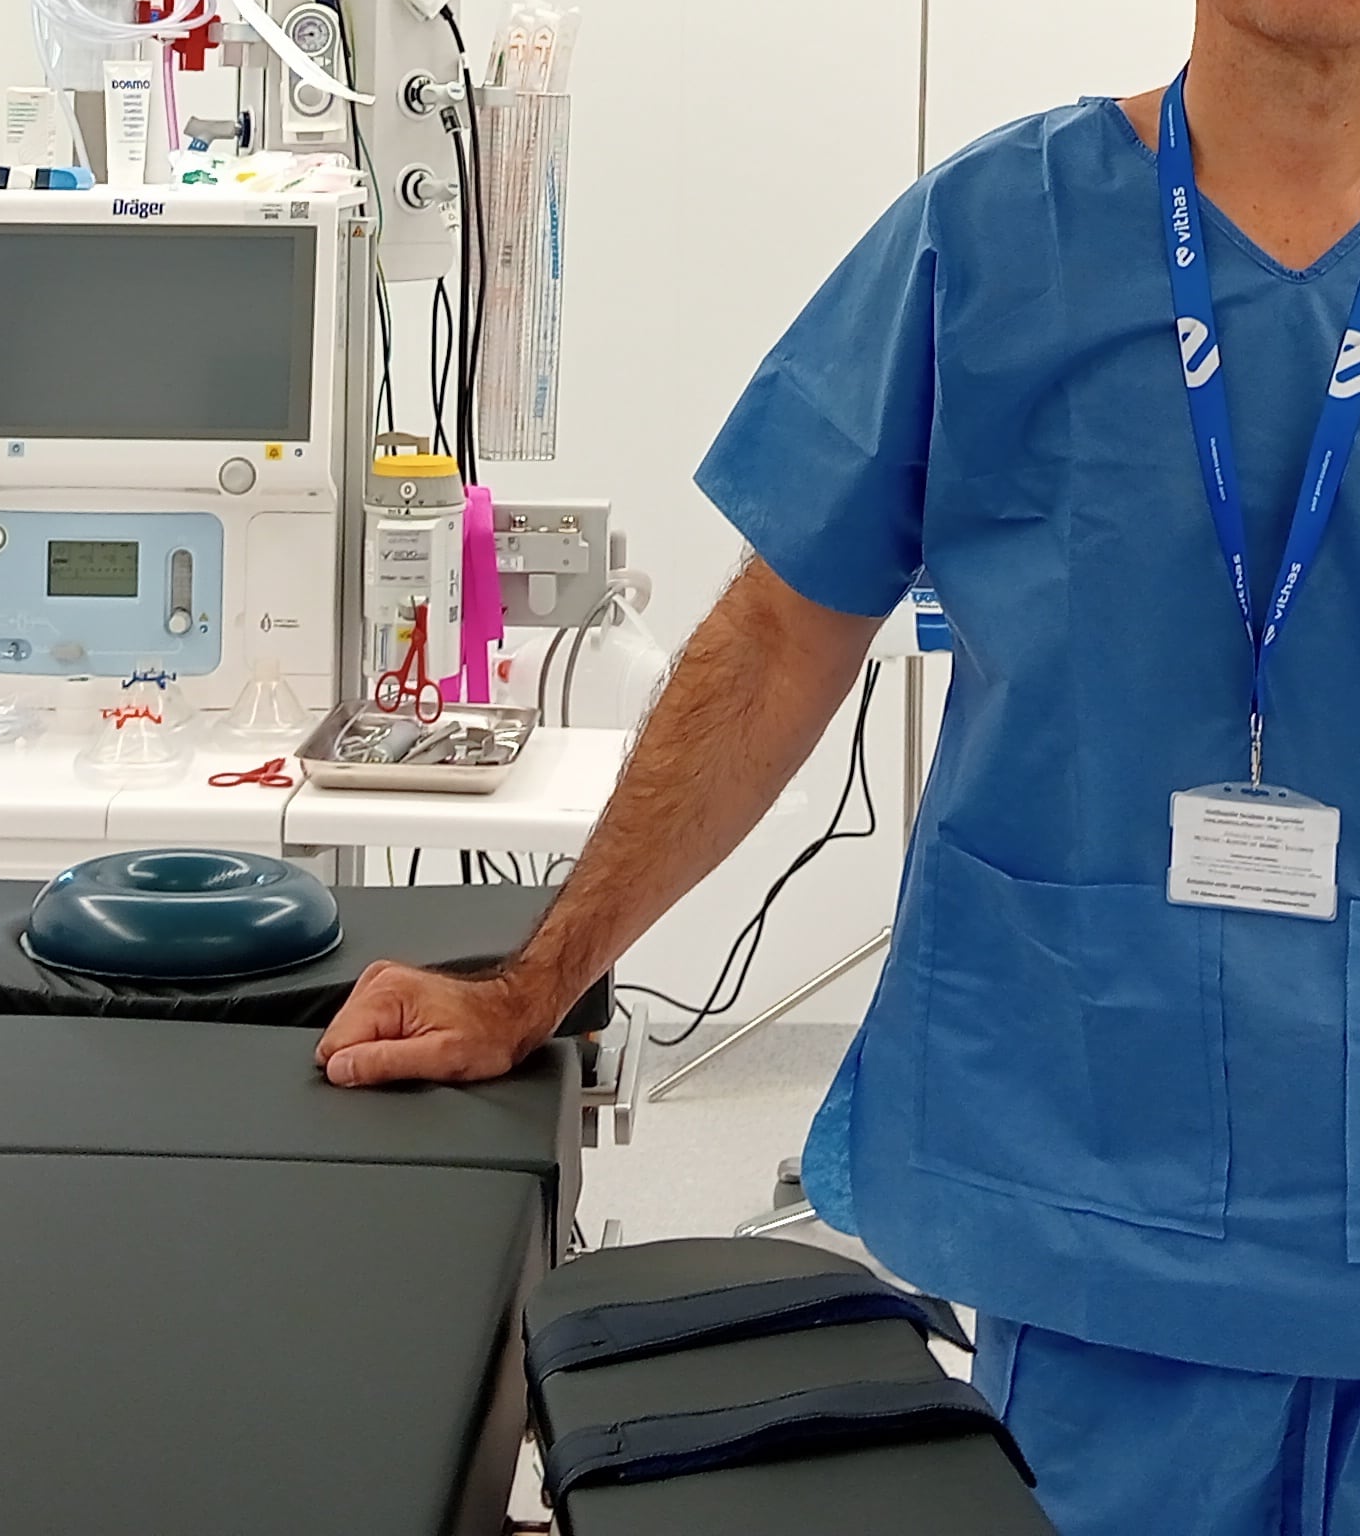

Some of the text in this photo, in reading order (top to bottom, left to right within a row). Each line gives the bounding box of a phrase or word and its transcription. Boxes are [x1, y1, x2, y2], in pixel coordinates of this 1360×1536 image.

[112, 198, 166, 219] Dräger
[1172, 186, 1191, 243] vithas
[1274, 562, 1302, 620] vithas
